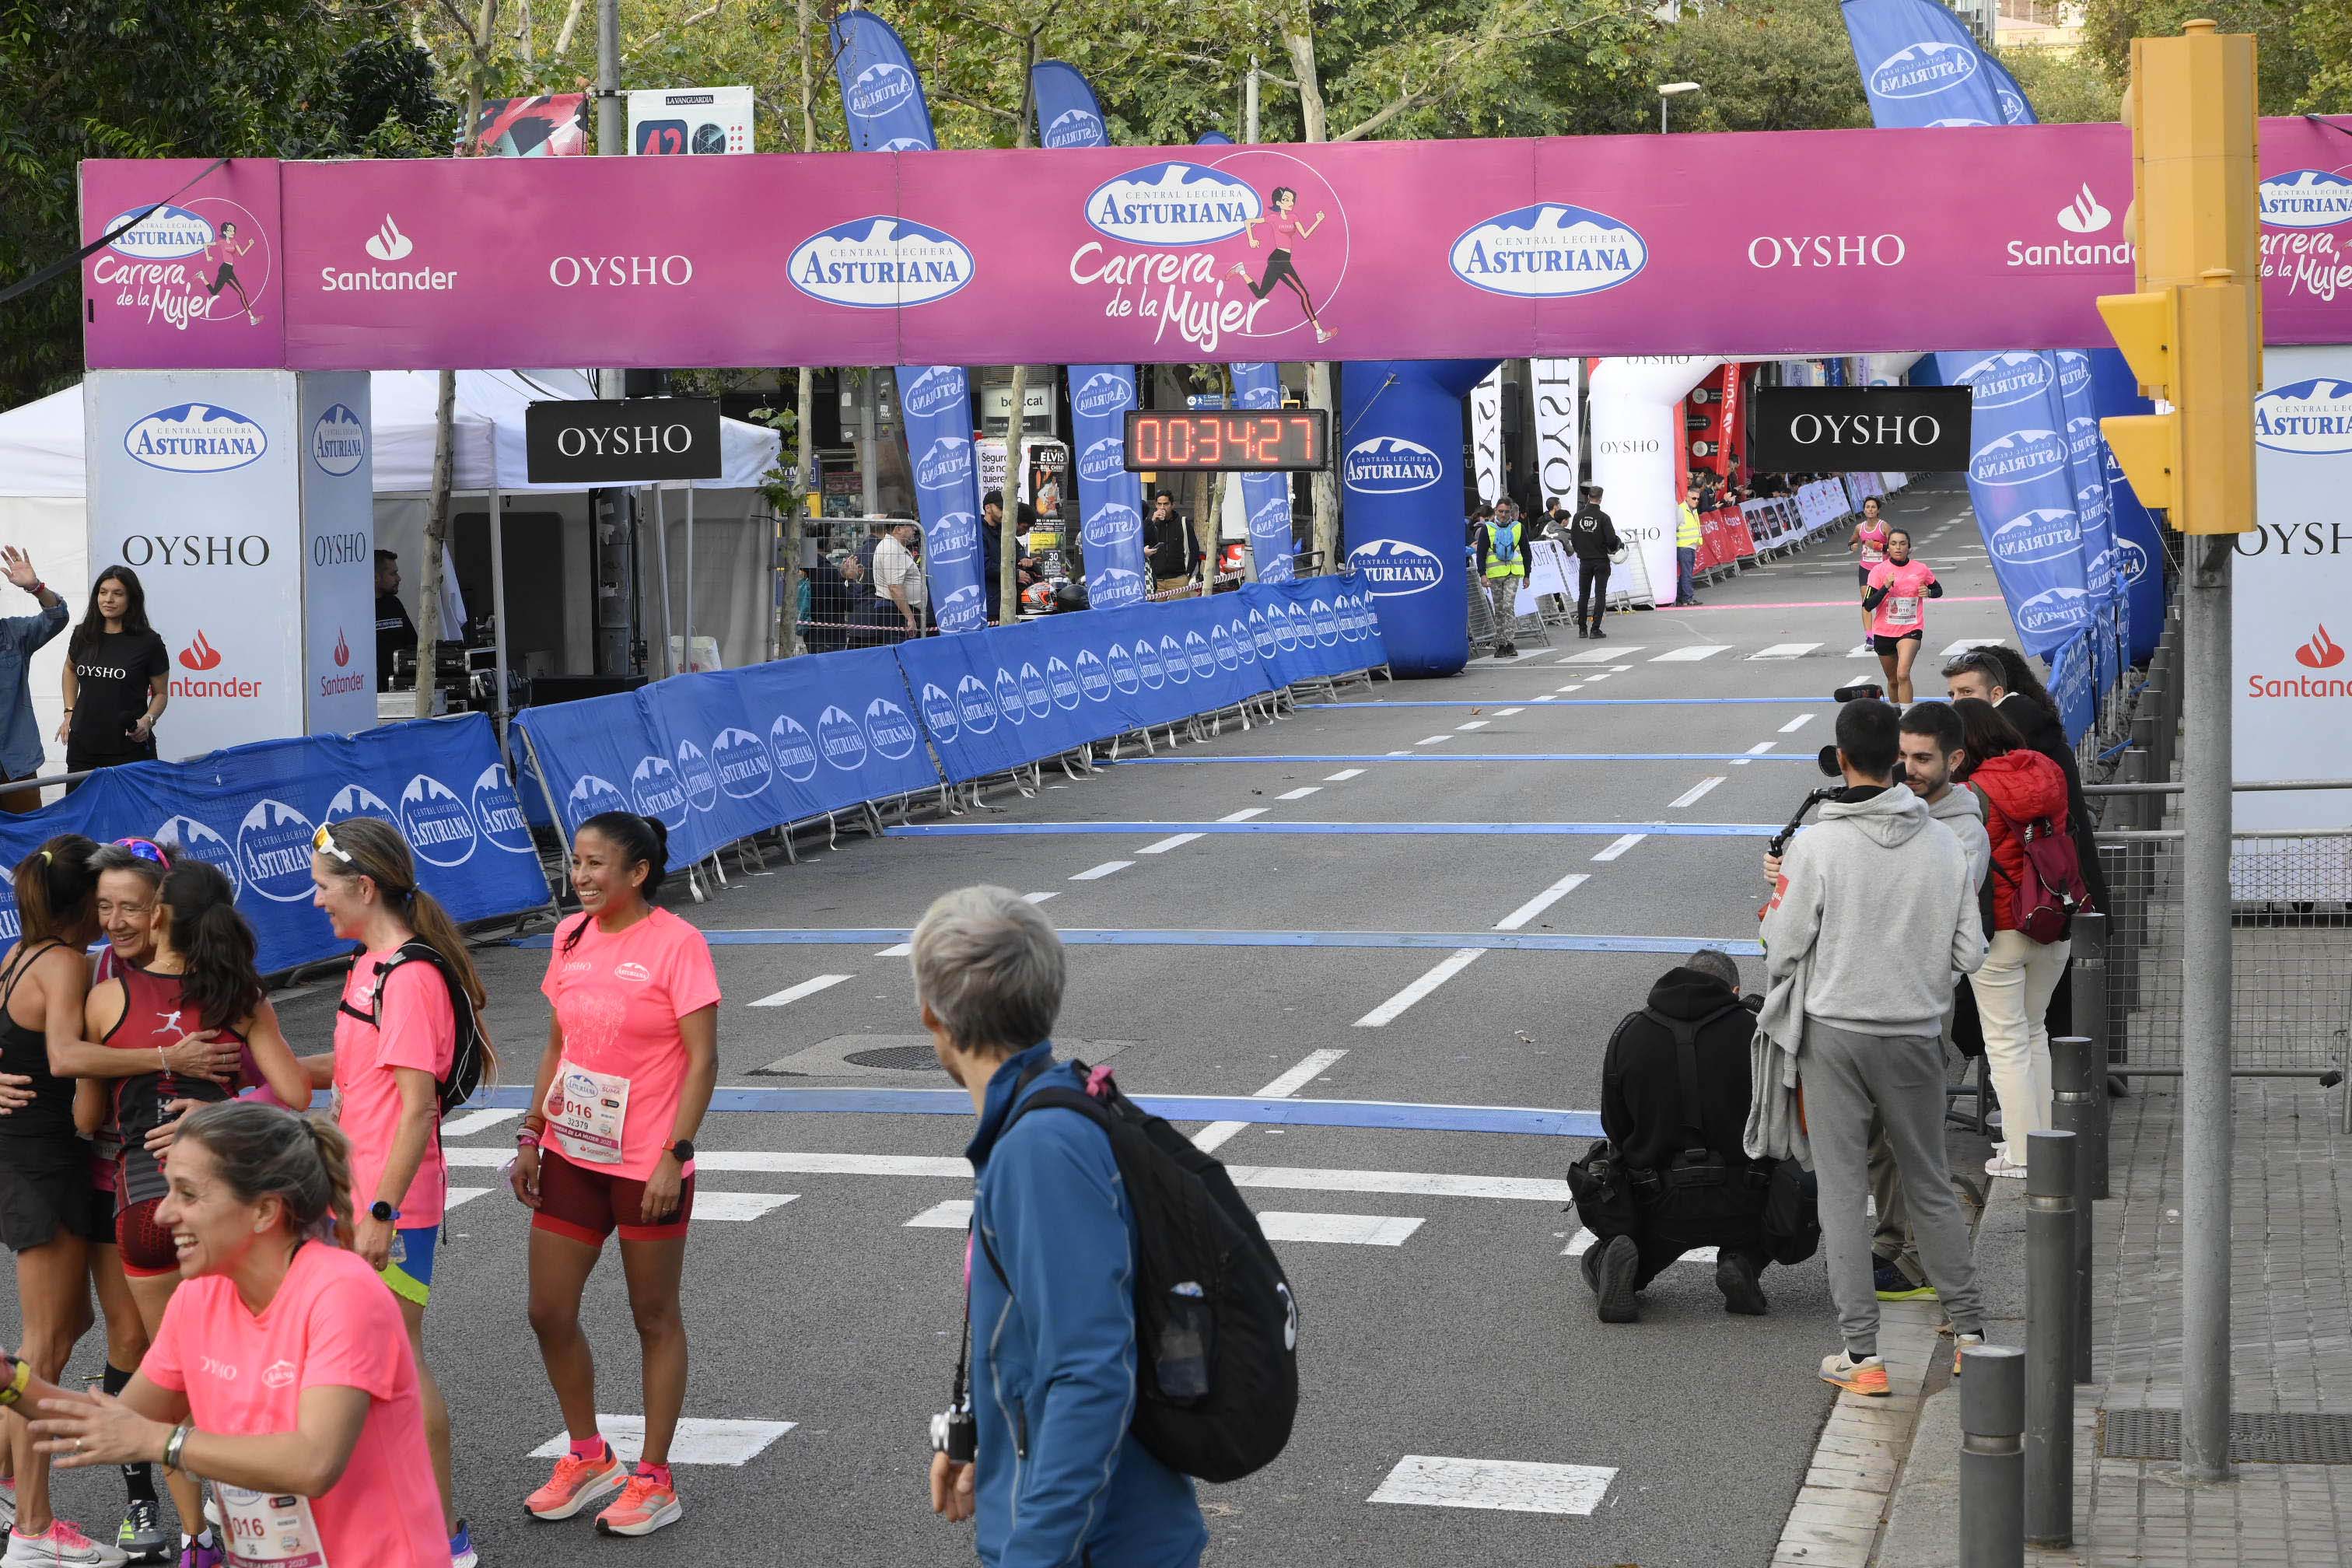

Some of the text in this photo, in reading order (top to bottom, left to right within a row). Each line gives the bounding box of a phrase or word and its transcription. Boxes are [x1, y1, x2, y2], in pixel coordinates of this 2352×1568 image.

[1125, 189, 1242, 199] CENTRAL LECHERA
[1098, 193, 1248, 225] ASTURIANA
[830, 247, 954, 257] CENTRAL LECHERA
[1495, 234, 1625, 246] CENTRAL LECHERA
[1748, 234, 1906, 268] OYSHO
[2007, 240, 2136, 266] Santand
[2259, 233, 2334, 255] arrera
[93, 255, 186, 285] Carrera
[802, 250, 961, 284] ASTURIANA
[1070, 242, 1216, 285] Carrera
[1465, 239, 1632, 274] ASTURIANA
[321, 266, 458, 292] Santander
[549, 254, 693, 287] OYSHO
[2278, 256, 2293, 277] la
[2289, 250, 2352, 302] Muje
[117, 282, 220, 330] de la Mujer
[1106, 279, 1270, 352] de la Mujer
[1791, 413, 1941, 446] OYSHO
[2256, 407, 2352, 436] ASTURIA
[135, 429, 257, 455] ASTURIANA
[317, 431, 362, 458] ASTURIANA
[558, 424, 693, 457] OYSHO
[1136, 418, 1313, 463] 00:34:27
[1601, 439, 1659, 455] OYSHO
[1040, 452, 1064, 462] ELVIS
[1347, 460, 1435, 481] ASTURIANA
[1623, 527, 1661, 541] SHO
[121, 534, 270, 567] OYSHO
[314, 531, 366, 567] OYSHO
[77, 664, 126, 680] OYSHO
[321, 670, 365, 697] Santander
[145, 677, 262, 698] ntander
[2249, 674, 2352, 698] Santan
[775, 744, 814, 768] ASTURIANA
[822, 732, 865, 757] ASTURIANA
[716, 755, 770, 786] ASTURIANA
[408, 811, 474, 848] ASTURIANA
[246, 842, 313, 881] ASTURIAN
[567, 1101, 592, 1118] 016
[568, 1117, 589, 1130] 32379
[586, 1146, 615, 1159] Santander
